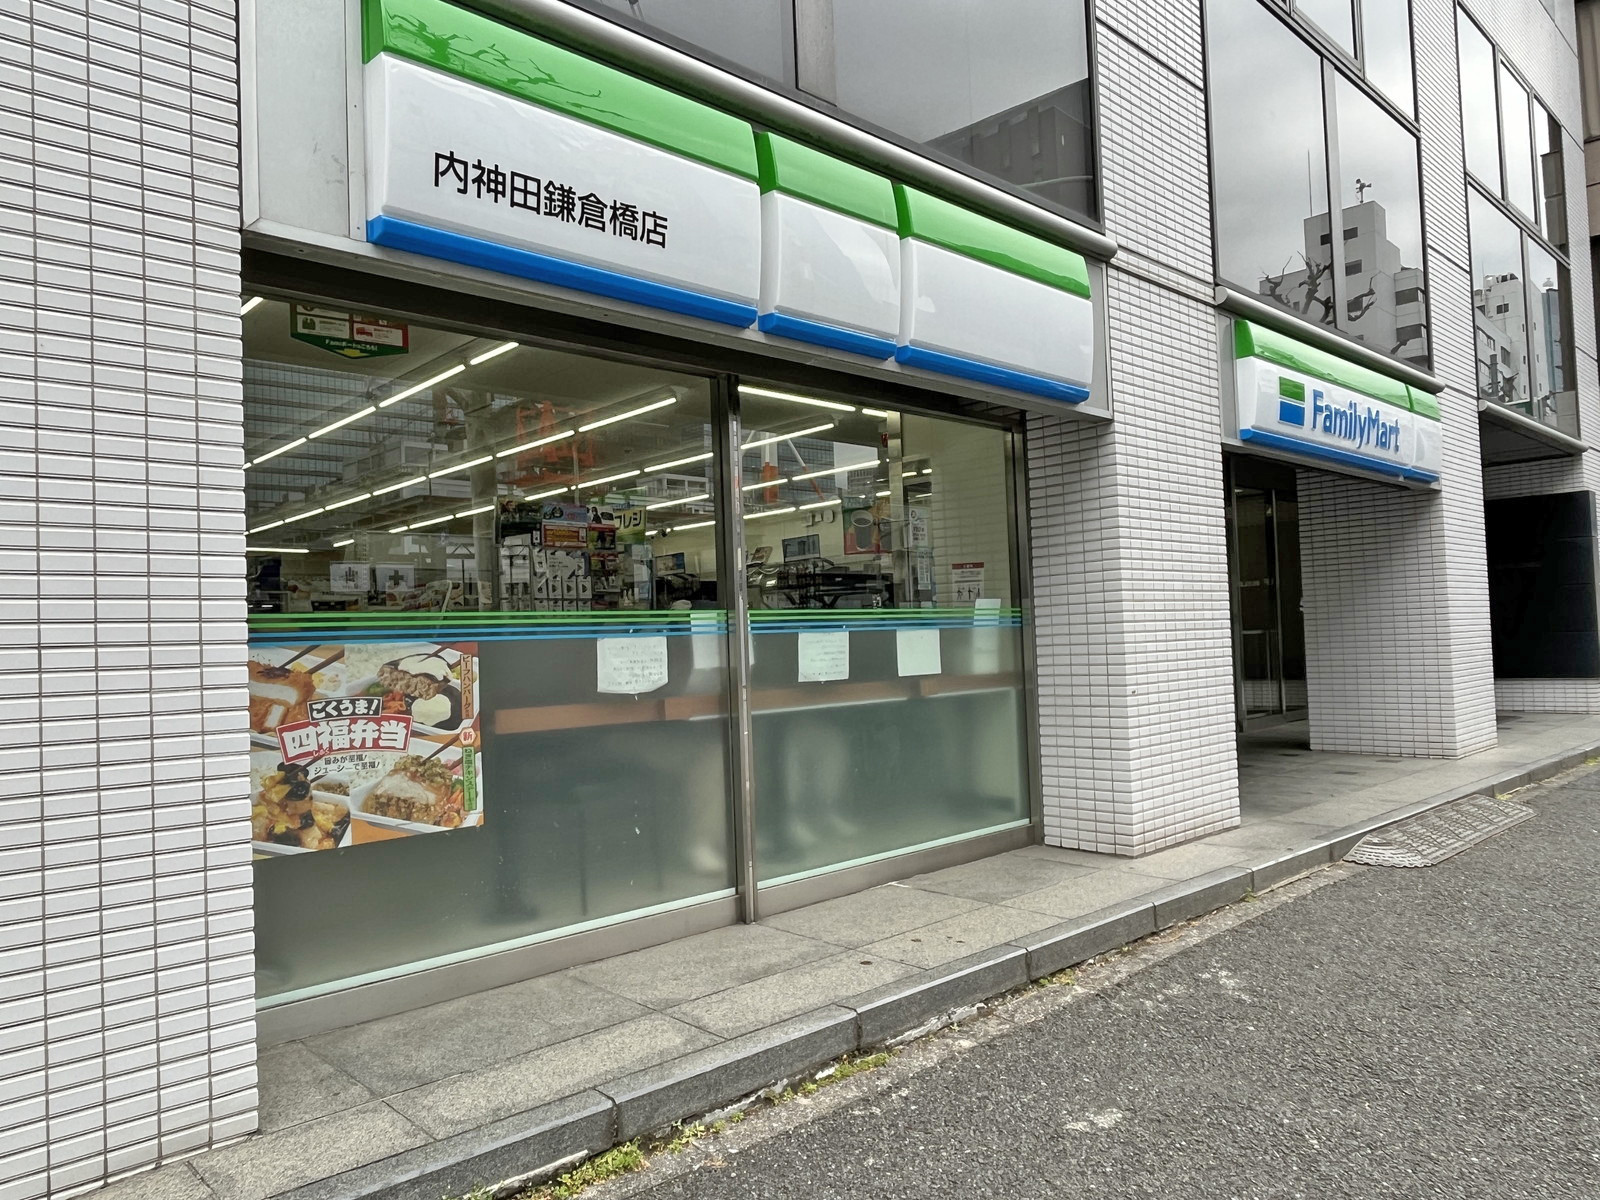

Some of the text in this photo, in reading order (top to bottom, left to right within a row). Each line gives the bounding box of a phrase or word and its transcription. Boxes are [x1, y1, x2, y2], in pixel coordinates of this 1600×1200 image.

[434, 150, 668, 249] 内神田鎌倉橋店
[1312, 389, 1401, 453] FamilyMart
[312, 699, 379, 719] ごくうま!
[281, 719, 408, 758] 四福弁当
